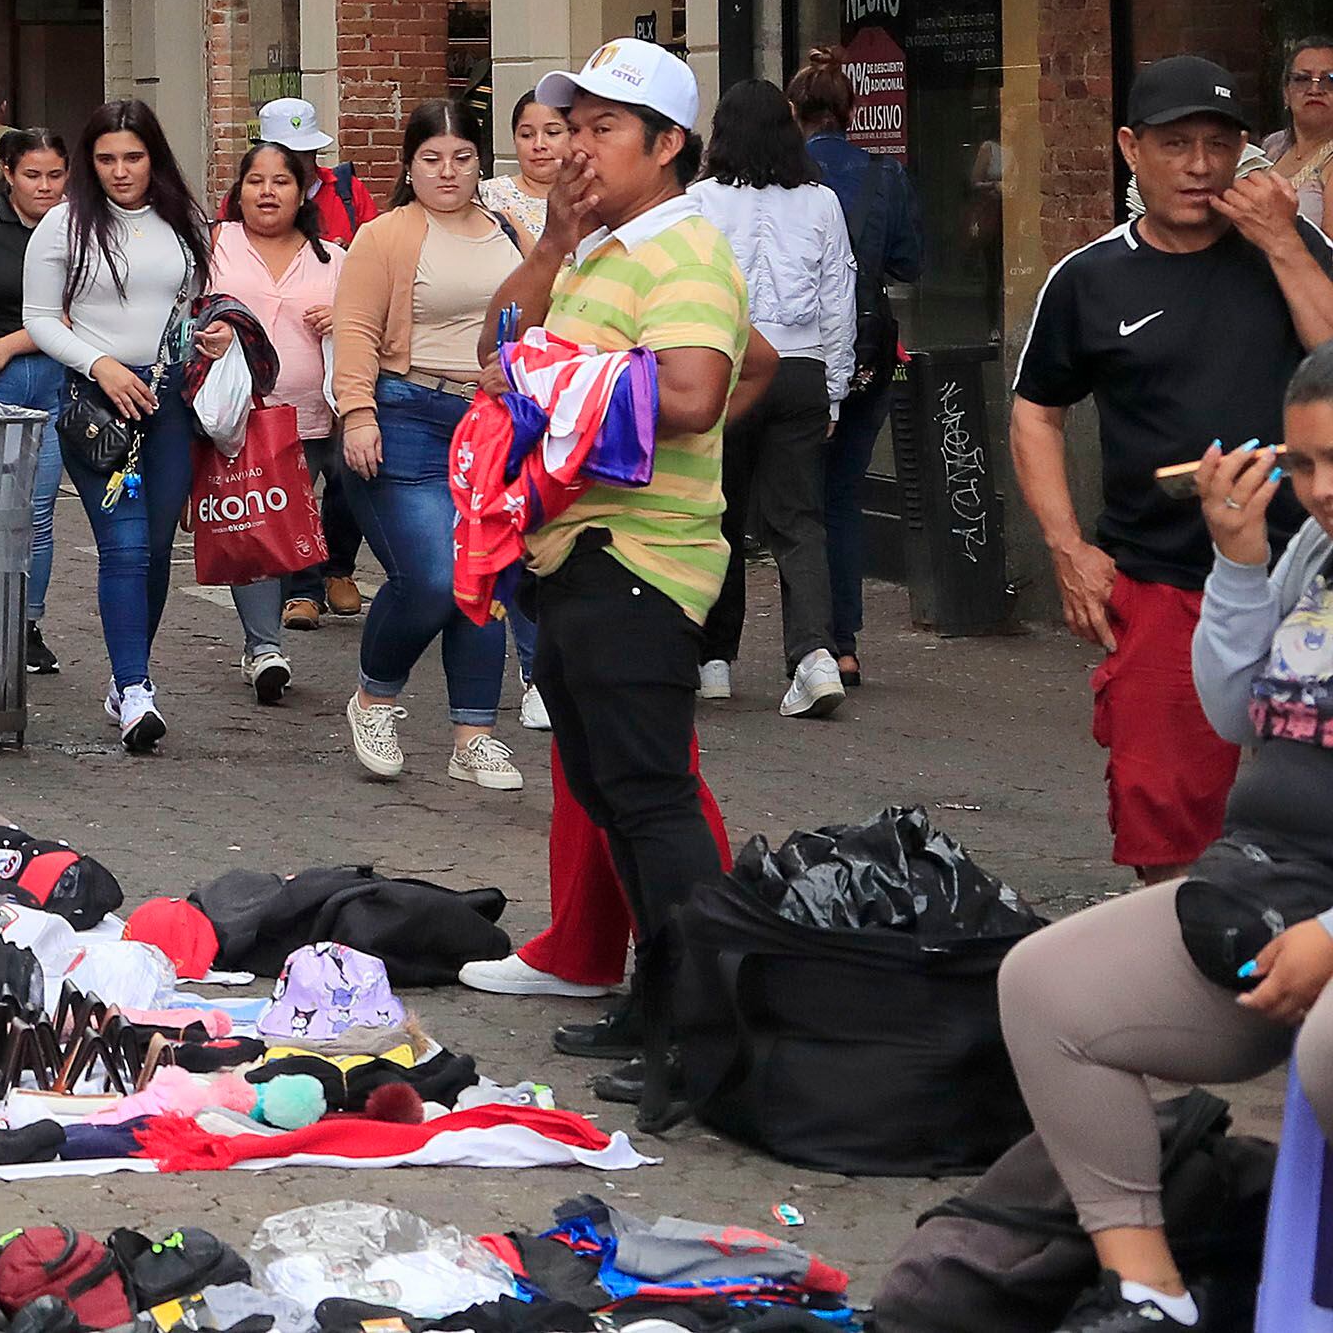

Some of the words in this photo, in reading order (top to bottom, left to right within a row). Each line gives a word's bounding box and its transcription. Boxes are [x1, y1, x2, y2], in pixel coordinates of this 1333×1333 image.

[637, 21, 654, 40] PLX
[874, 61, 904, 73] DESCUENTO
[871, 77, 904, 92] ADICIONAL
[846, 104, 902, 131] XCLUSIVO
[198, 486, 288, 523] ekono
